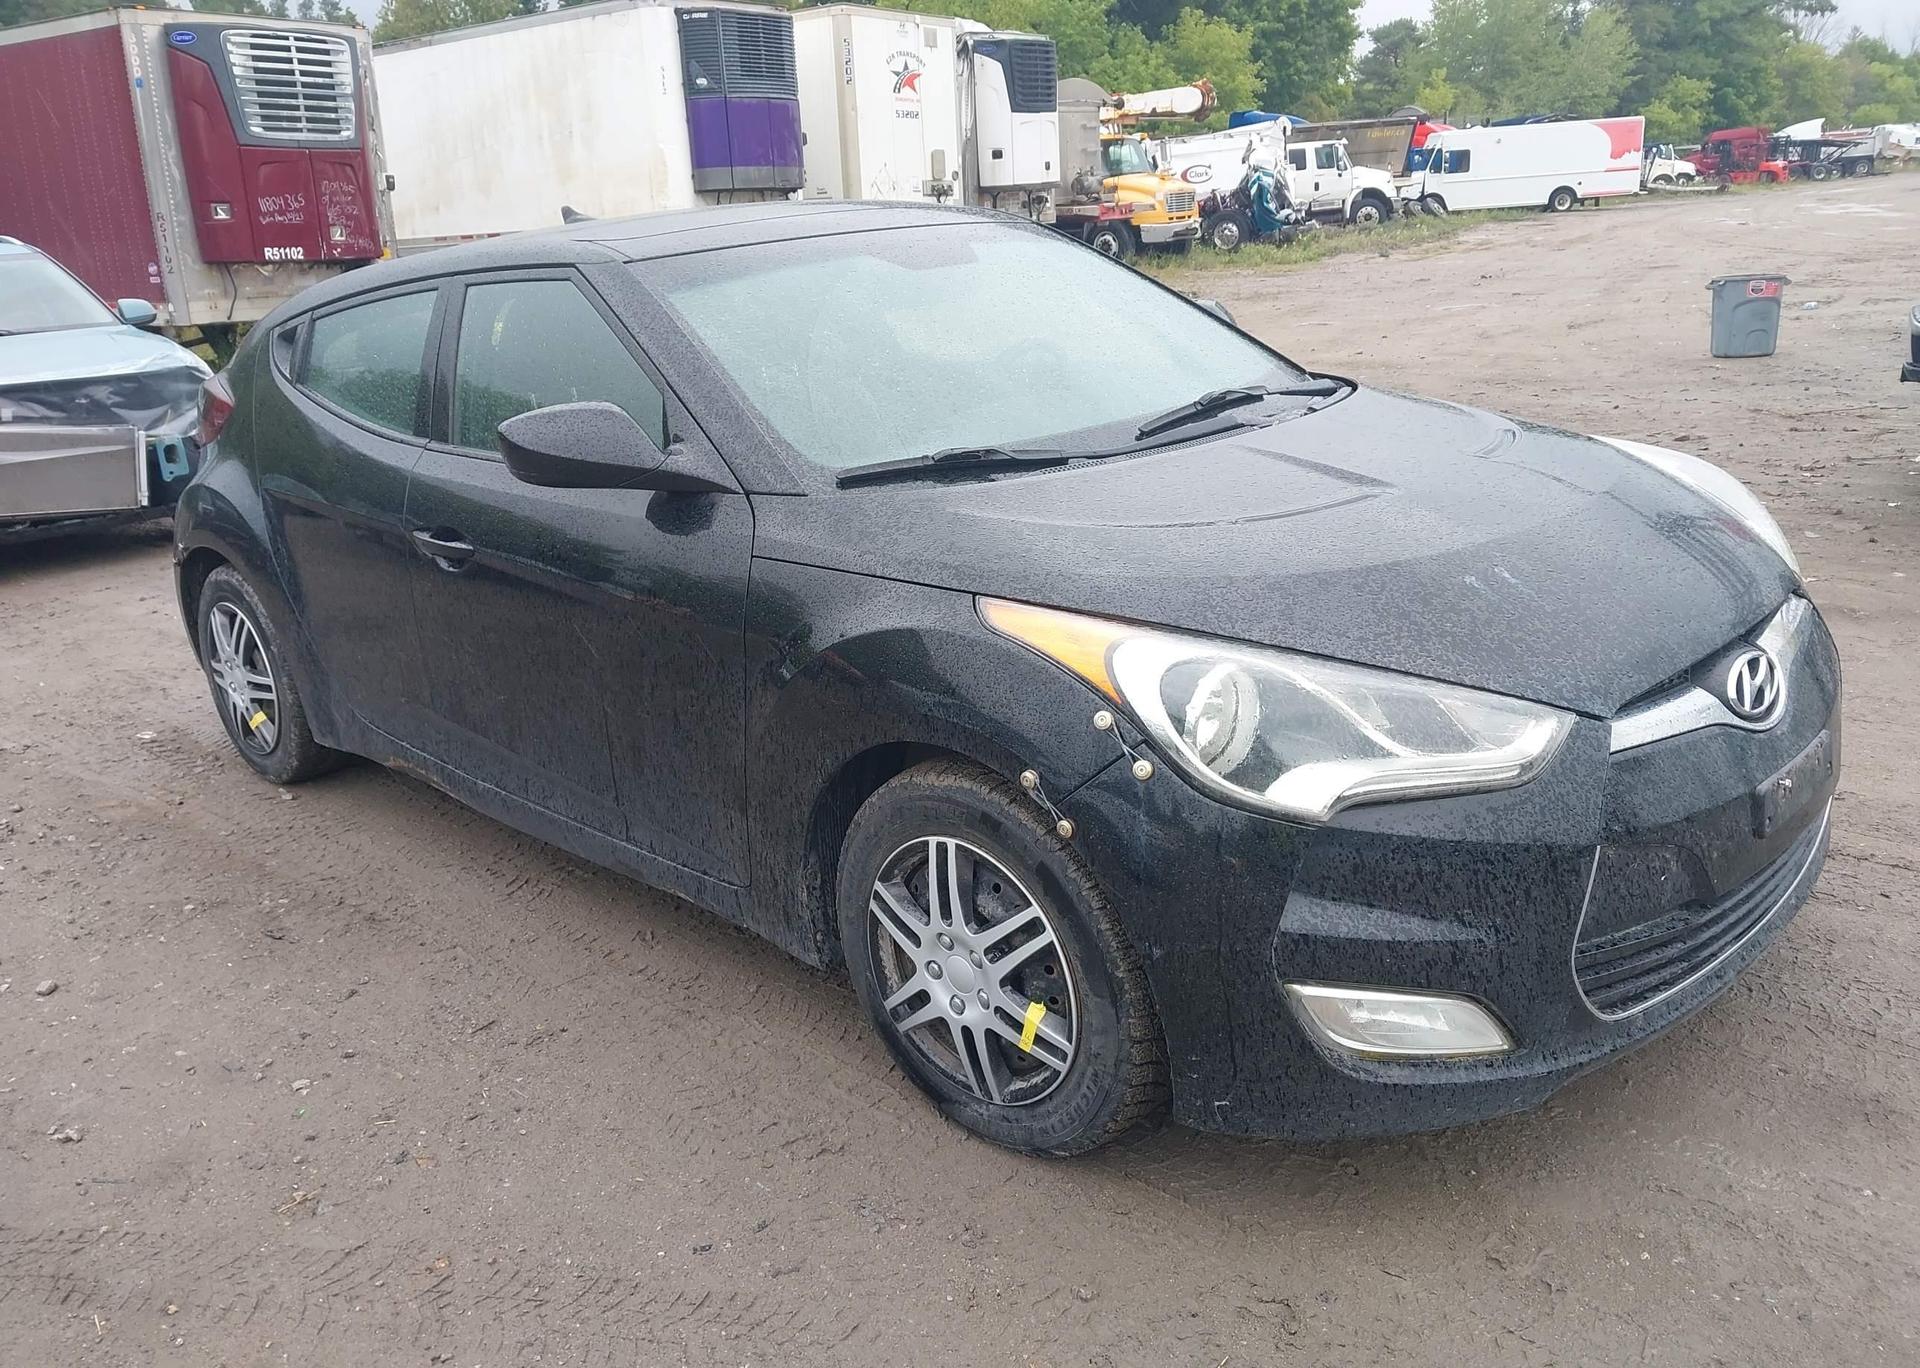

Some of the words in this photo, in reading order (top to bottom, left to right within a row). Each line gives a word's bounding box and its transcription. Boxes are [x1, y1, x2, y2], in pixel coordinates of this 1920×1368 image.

[843, 38, 852, 85] 53202
[896, 50, 926, 68] TRANSPORT
[895, 109, 920, 119] 53202
[1188, 168, 1209, 179] Clark
[263, 246, 304, 260] R51102
